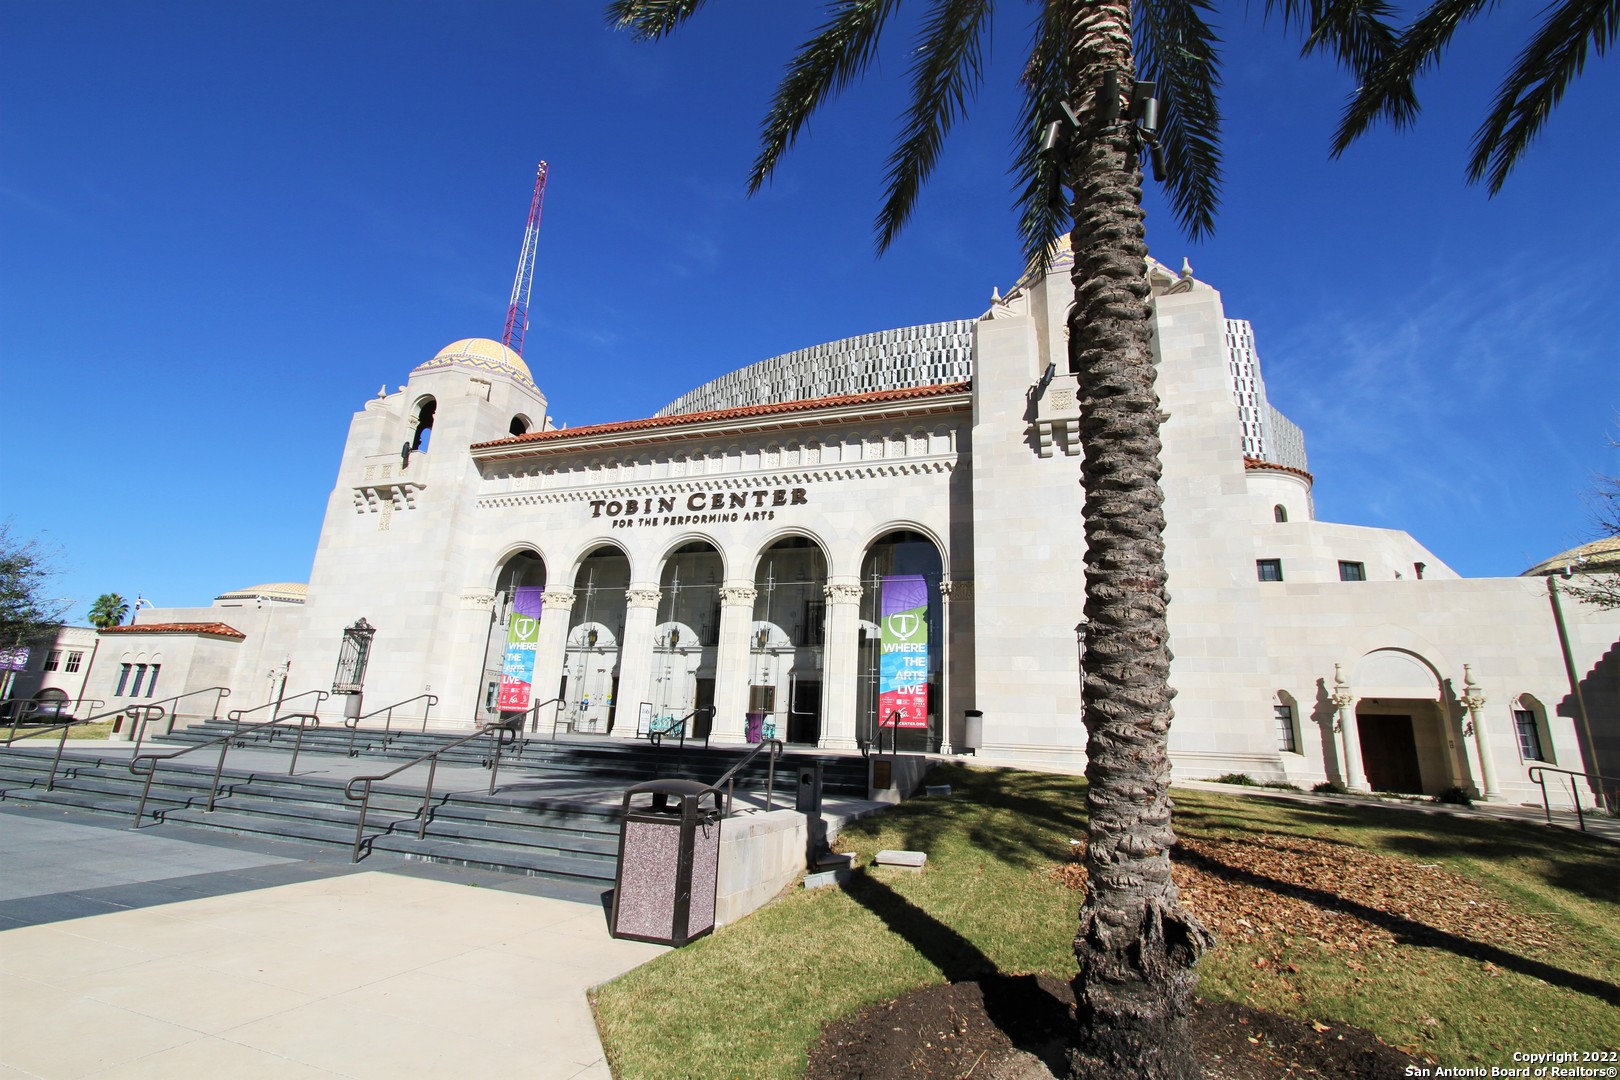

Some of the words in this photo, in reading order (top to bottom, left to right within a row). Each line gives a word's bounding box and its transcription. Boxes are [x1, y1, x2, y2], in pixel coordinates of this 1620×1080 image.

[589, 497, 676, 518] TOBIN
[687, 488, 808, 511] CENTER
[612, 519, 633, 528] FOR
[638, 517, 658, 527] THE
[663, 512, 738, 526] PERFORMING
[743, 511, 775, 521] ARTS
[508, 642, 537, 650] WHERE
[883, 642, 926, 652] WHERE
[507, 653, 522, 661] THE
[903, 656, 926, 667] THE
[505, 664, 525, 672] ARTS
[895, 670, 926, 680] ARTS
[897, 685, 926, 694] LIVE.
